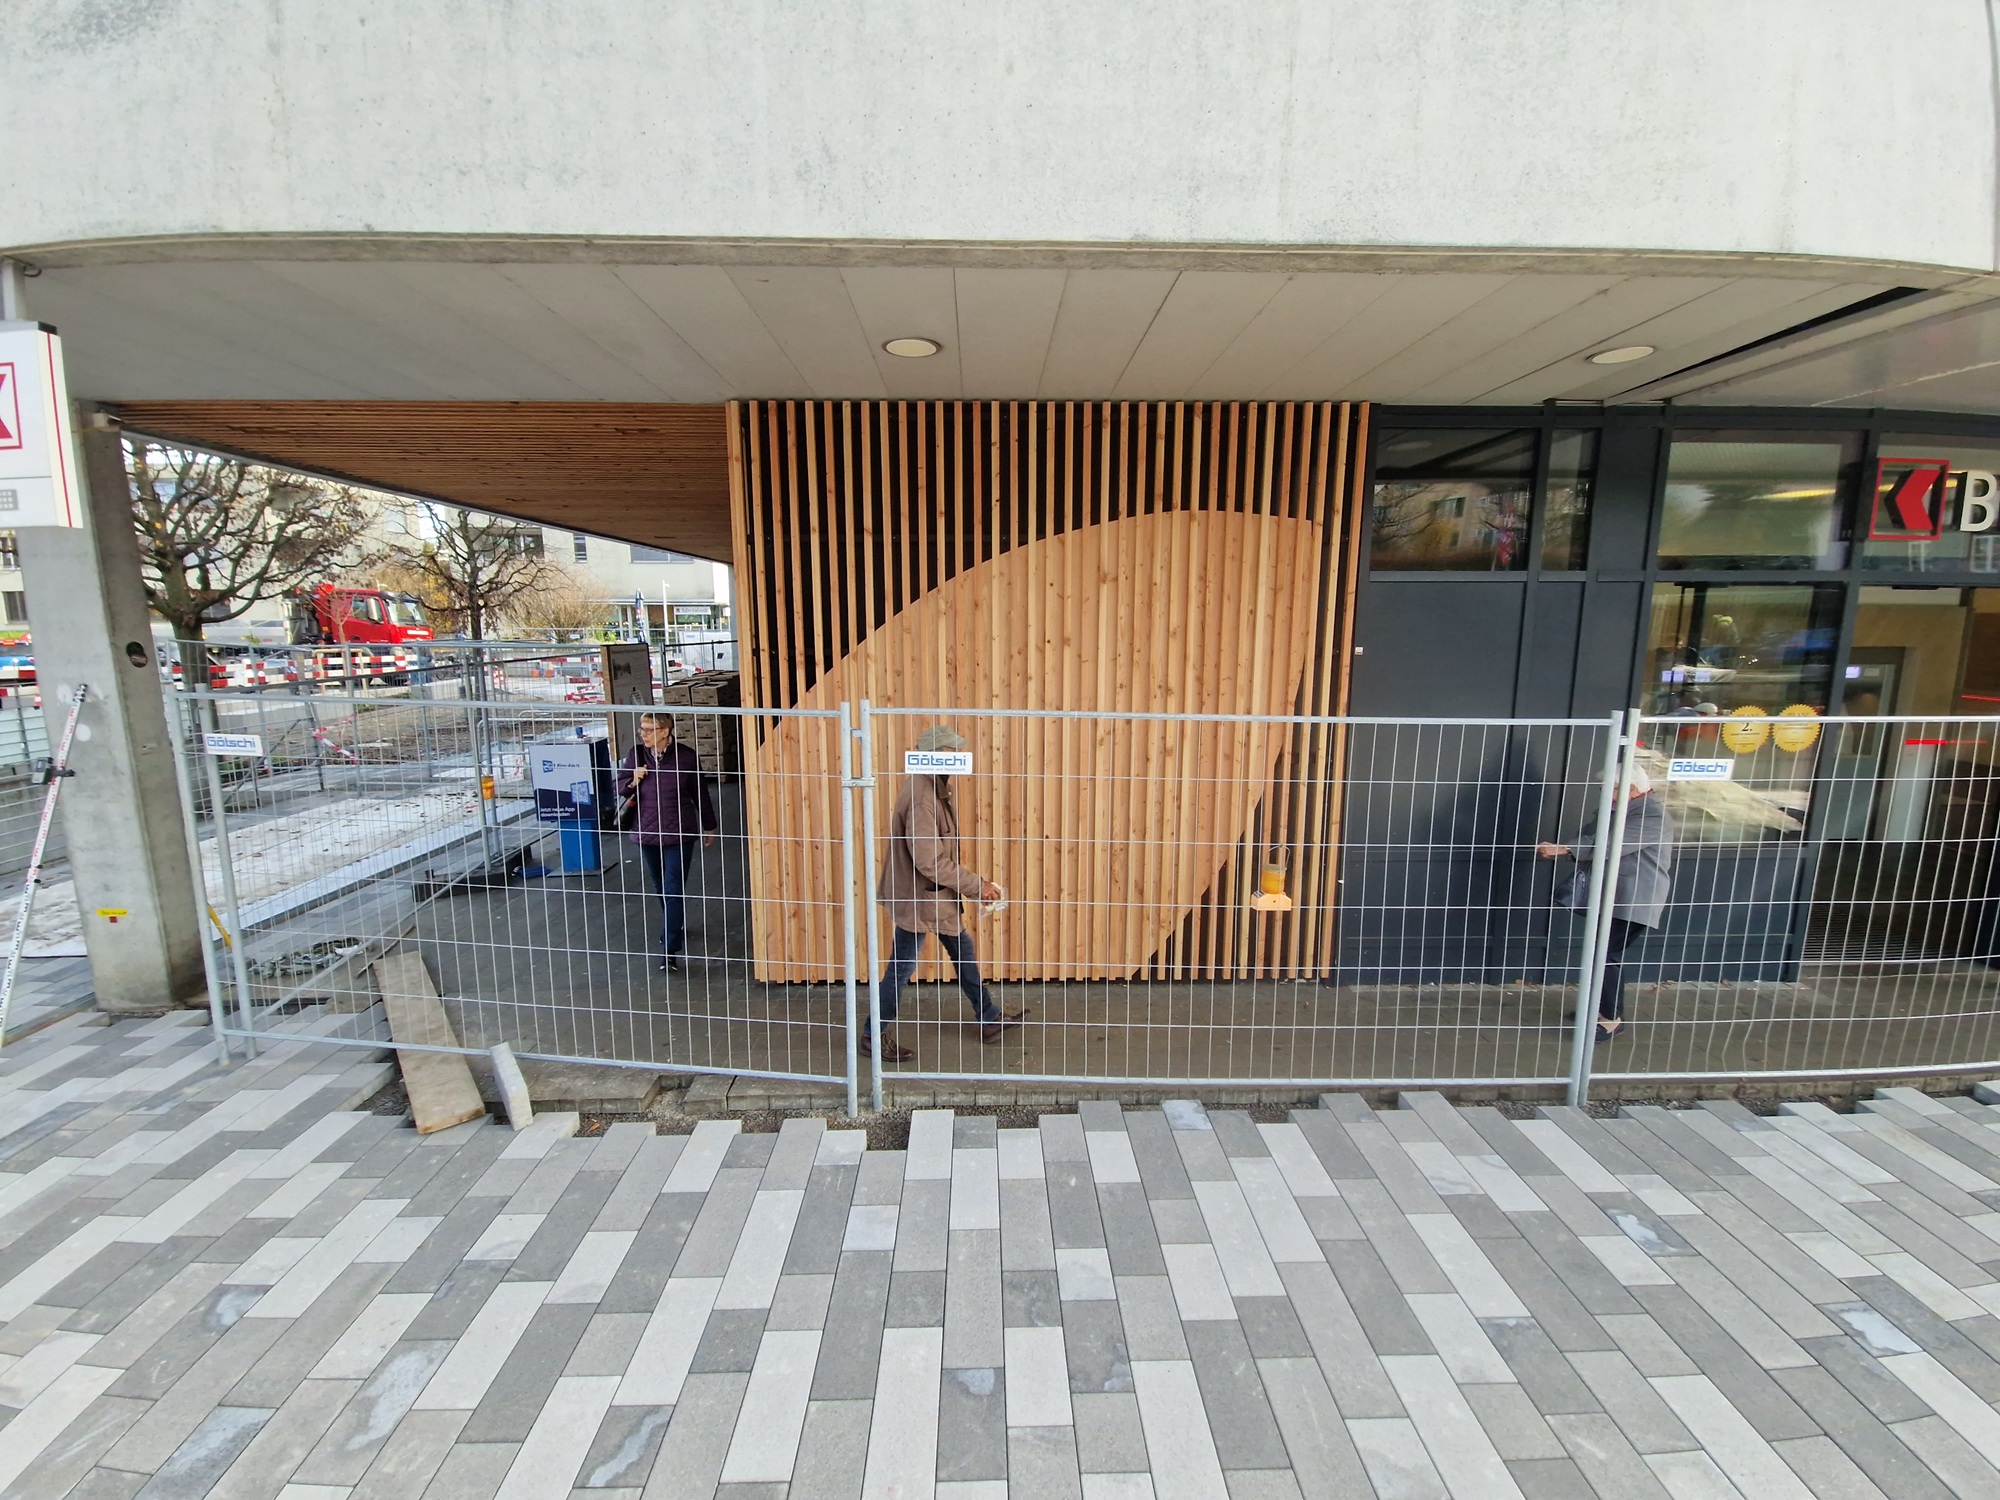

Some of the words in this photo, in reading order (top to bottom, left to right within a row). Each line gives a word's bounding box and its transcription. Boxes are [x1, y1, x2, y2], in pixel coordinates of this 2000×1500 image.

[1960, 469, 1998, 532] B
[207, 736, 256, 748] Götschi
[907, 754, 966, 766] Götschi
[1671, 761, 1728, 773] Götschi
